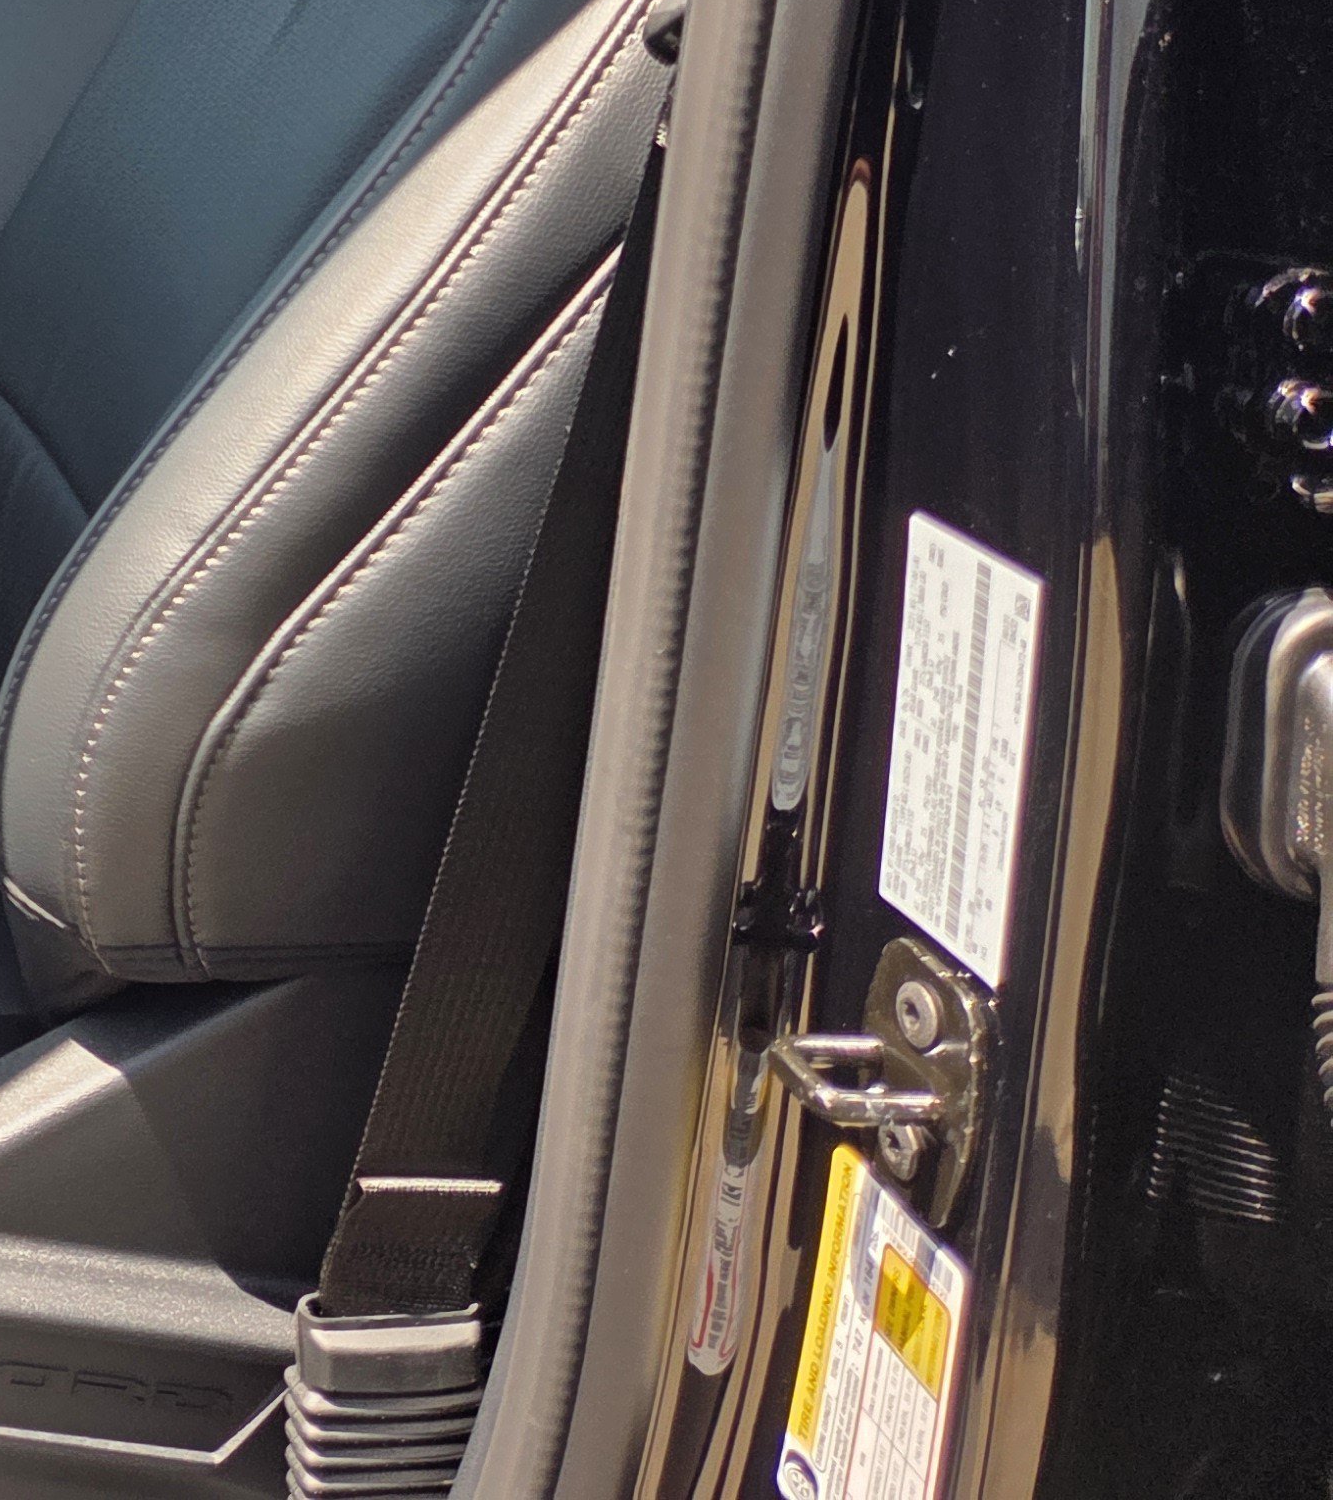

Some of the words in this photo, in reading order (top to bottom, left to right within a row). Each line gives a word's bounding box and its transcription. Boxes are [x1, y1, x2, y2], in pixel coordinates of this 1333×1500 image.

[824, 1160, 852, 1282] INFORMATION
[812, 1280, 833, 1362] LOADING
[806, 1359, 819, 1401] AND
[797, 1397, 813, 1443] TIRE
